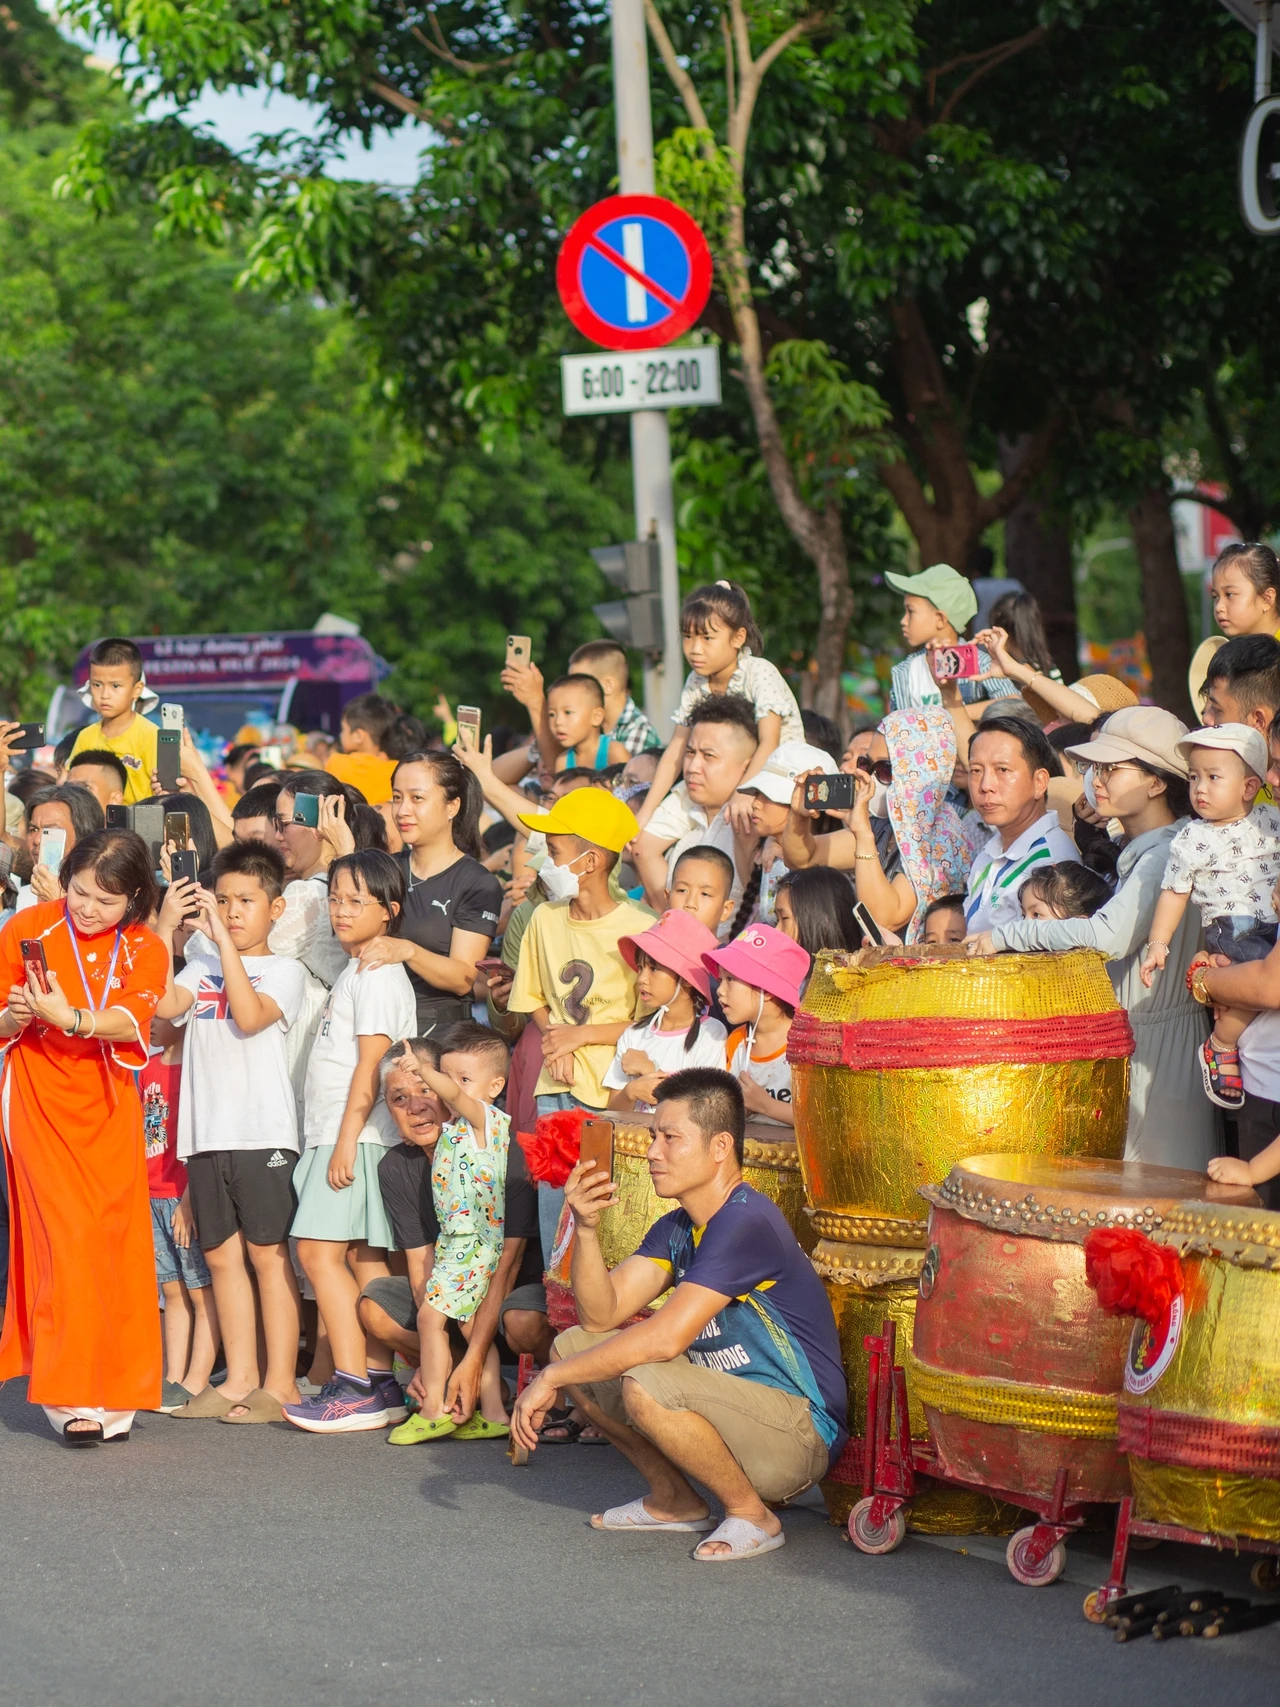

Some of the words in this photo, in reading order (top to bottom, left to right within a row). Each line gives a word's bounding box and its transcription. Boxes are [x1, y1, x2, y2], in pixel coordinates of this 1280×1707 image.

[582, 365, 623, 400] 6:00
[646, 359, 700, 394] 22:00
[558, 959, 594, 1026] 2
